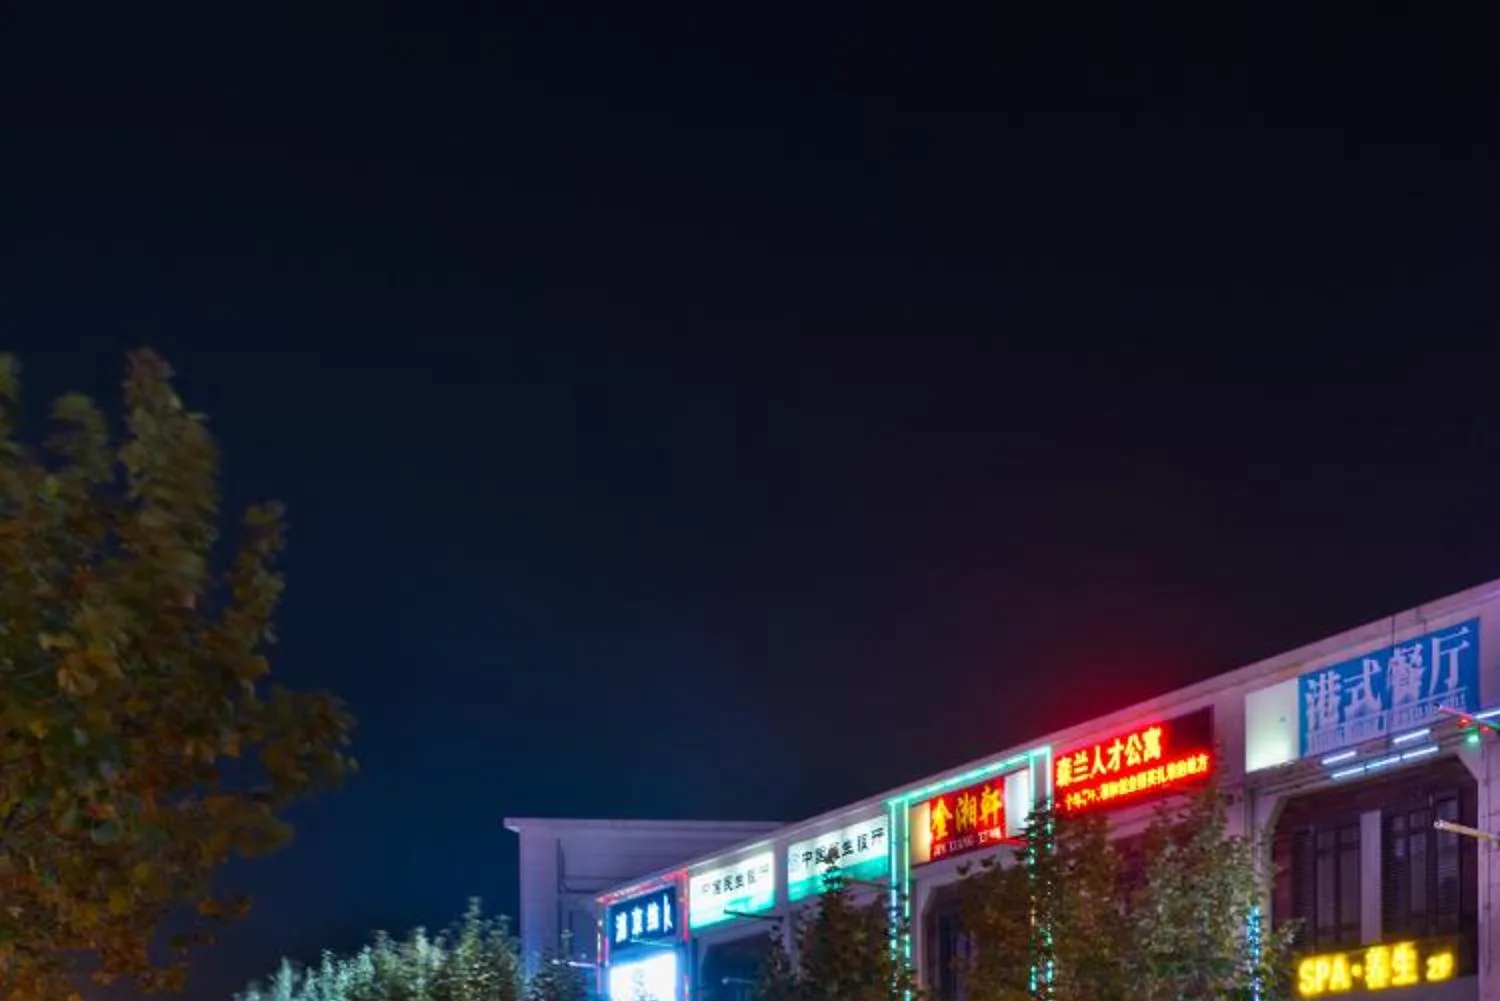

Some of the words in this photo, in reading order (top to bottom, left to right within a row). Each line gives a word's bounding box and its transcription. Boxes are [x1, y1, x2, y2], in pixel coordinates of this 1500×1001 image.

[1306, 626, 1470, 735] 港式餐厅
[801, 827, 885, 868] 中国生银行
